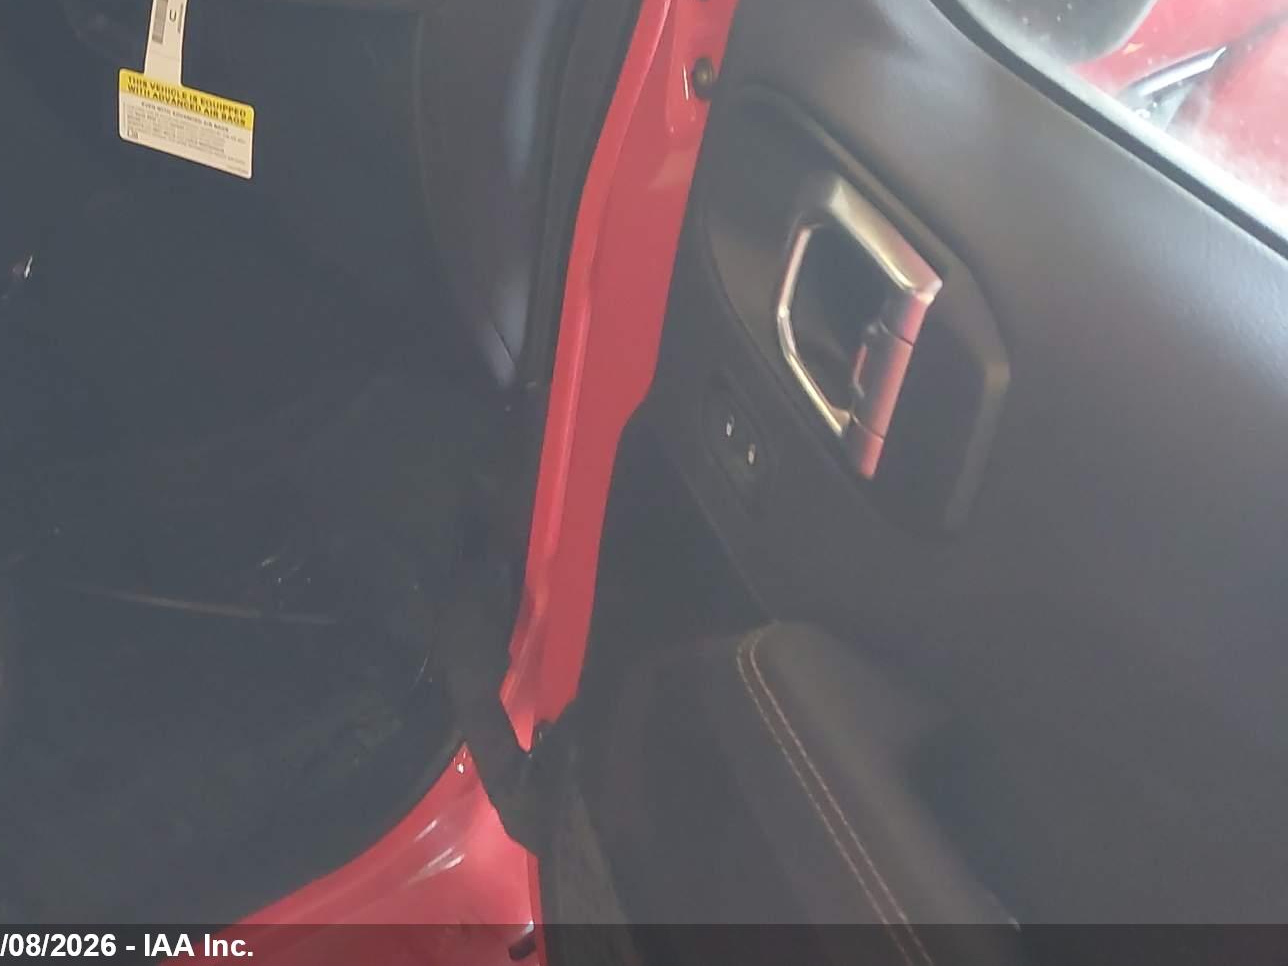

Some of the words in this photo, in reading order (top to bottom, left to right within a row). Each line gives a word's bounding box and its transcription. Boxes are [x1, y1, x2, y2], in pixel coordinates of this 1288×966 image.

[127, 85, 150, 98] WITH
[152, 92, 202, 113] ADVANCED
[203, 109, 219, 120] AIR
[221, 112, 246, 125] BAGS
[128, 76, 147, 89] THIS
[150, 81, 189, 99] VEHICLE
[190, 93, 198, 101] IS
[200, 96, 247, 117] EQUIPPED
